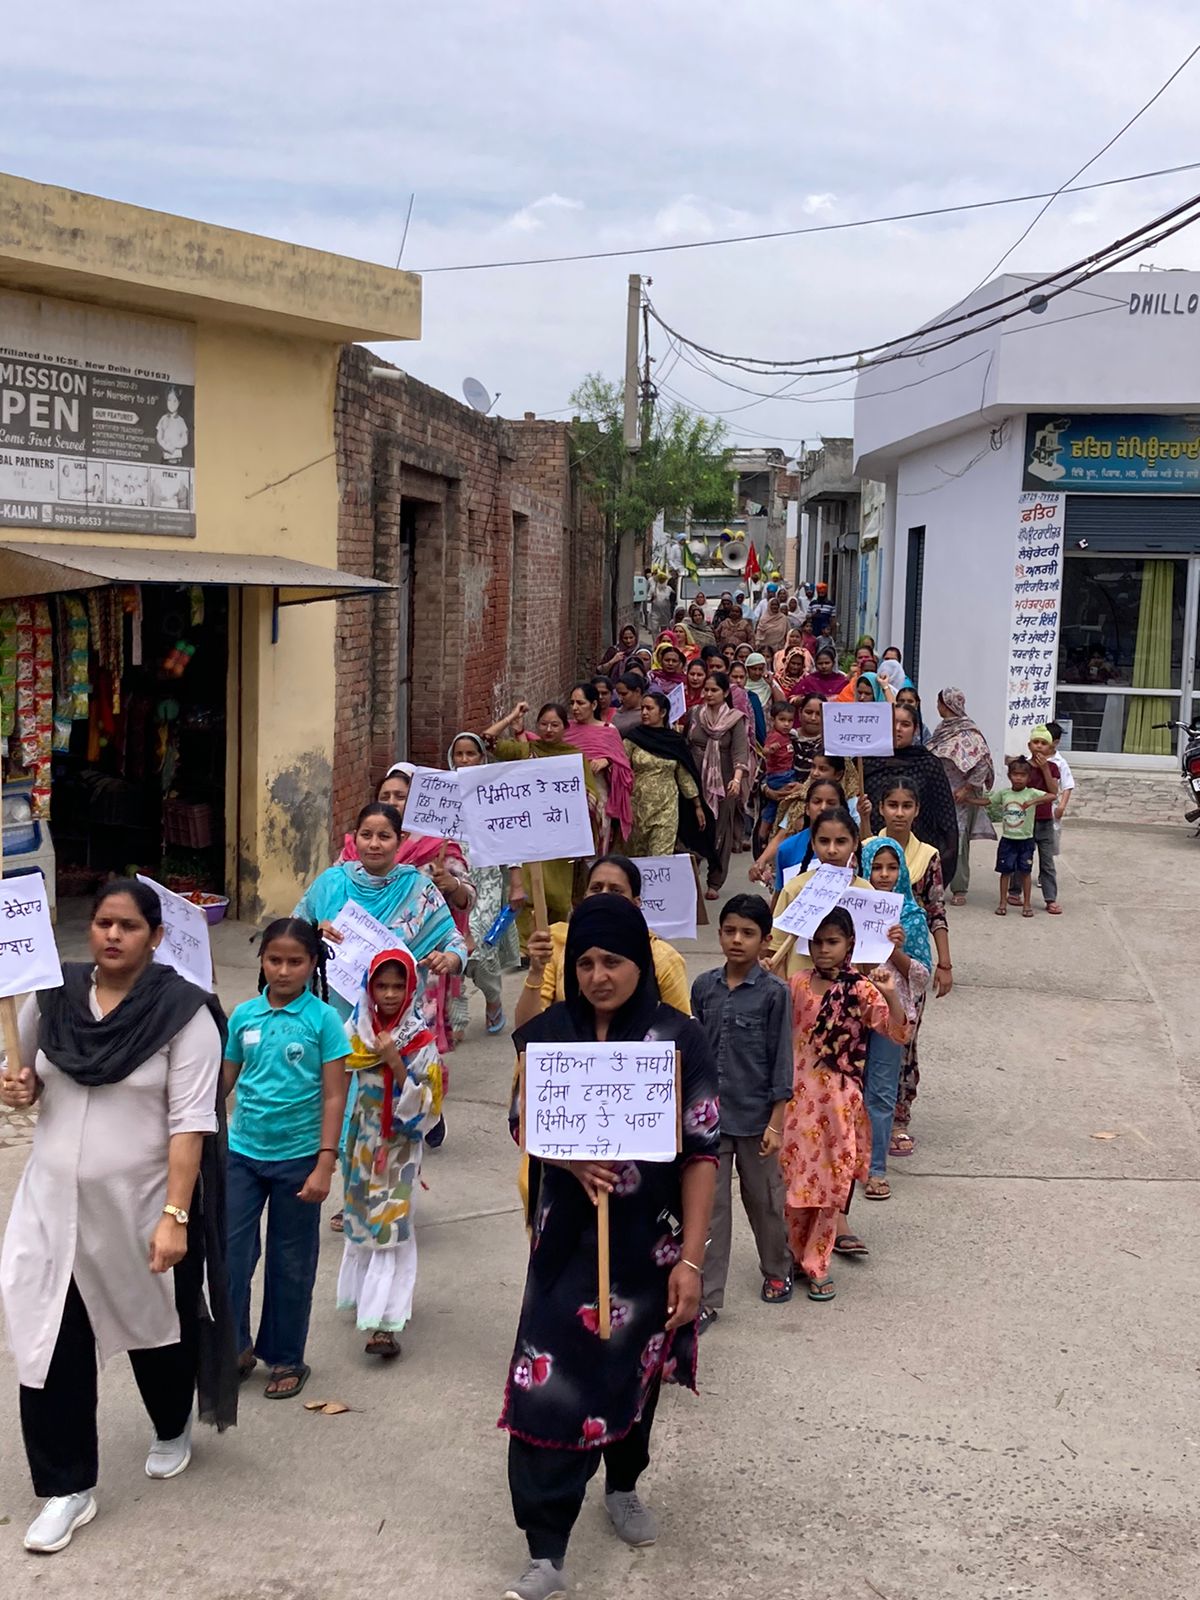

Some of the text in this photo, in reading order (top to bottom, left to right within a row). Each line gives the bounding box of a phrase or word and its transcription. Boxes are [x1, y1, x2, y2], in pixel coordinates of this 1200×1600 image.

[43, 354, 54, 362] to
[86, 361, 104, 370] New
[108, 364, 131, 374] Delhi
[0, 363, 87, 396] MISSION
[92, 388, 105, 397] For
[106, 390, 136, 404] Nursery
[136, 395, 144, 404] to
[2, 389, 80, 433] PEN
[27, 431, 52, 448] First
[54, 434, 86, 452] Served
[16, 456, 54, 470] PARTNERS
[1020, 503, 1058, 523] ਫ਼ਤਿਹ
[1011, 630, 1028, 644] ਅਤੇ
[1044, 662, 1052, 677] ਹੈ
[536, 778, 548, 793] ਤੇ
[484, 811, 532, 832] ਕਾਰਵਾਈ
[636, 1050, 674, 1074] ਜਬਰੀ
[644, 1078, 674, 1104] ਵਾਲੀ
[595, 1105, 616, 1128] ਤੇ
[624, 1112, 665, 1132] ਪਰਚਾ
